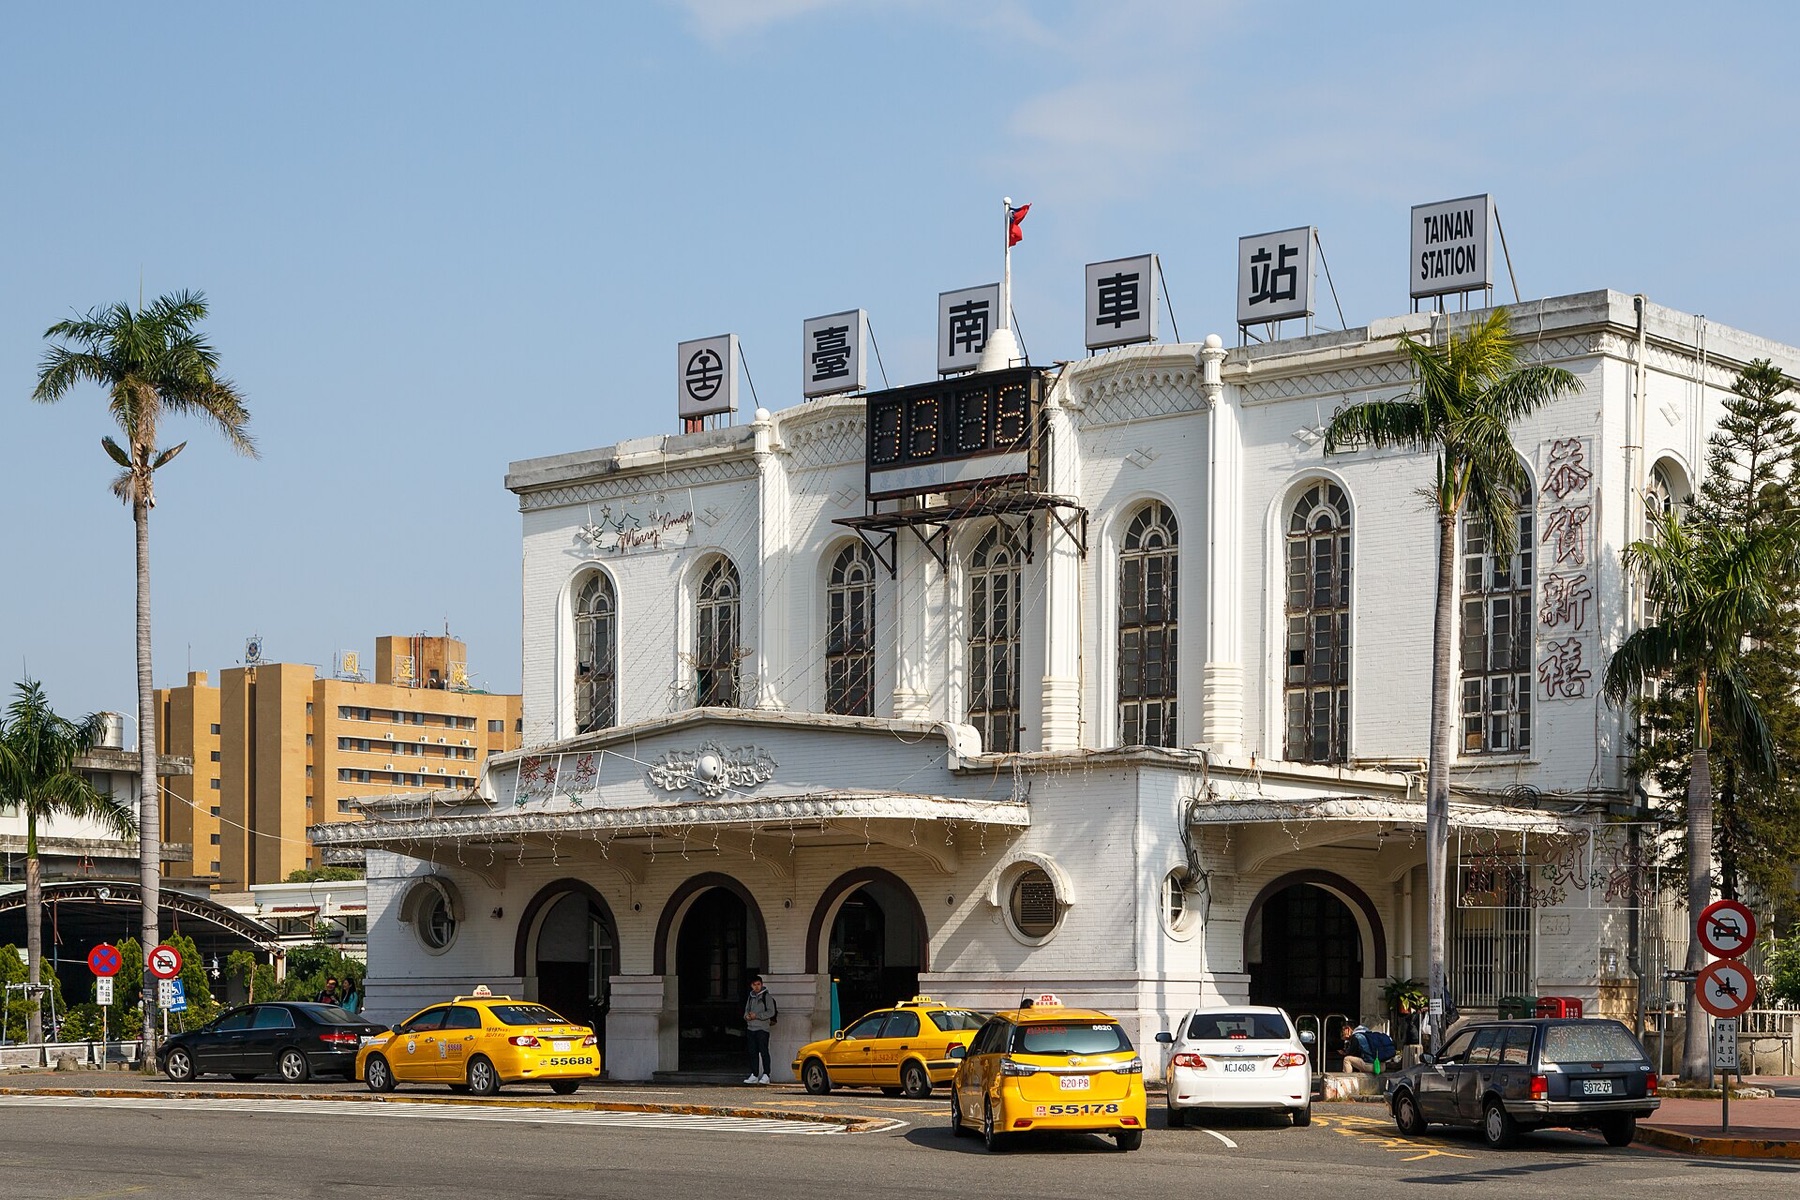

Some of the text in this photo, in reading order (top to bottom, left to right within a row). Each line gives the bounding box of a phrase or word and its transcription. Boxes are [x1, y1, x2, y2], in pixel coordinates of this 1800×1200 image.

[1423, 209, 1474, 245] TAINAN
[1421, 244, 1476, 280] STATION
[811, 243, 1299, 383] 臺 南 車 站
[620, 528, 660, 554] Merry
[550, 1057, 593, 1066] 55688
[1049, 1103, 1119, 1115] 55178
